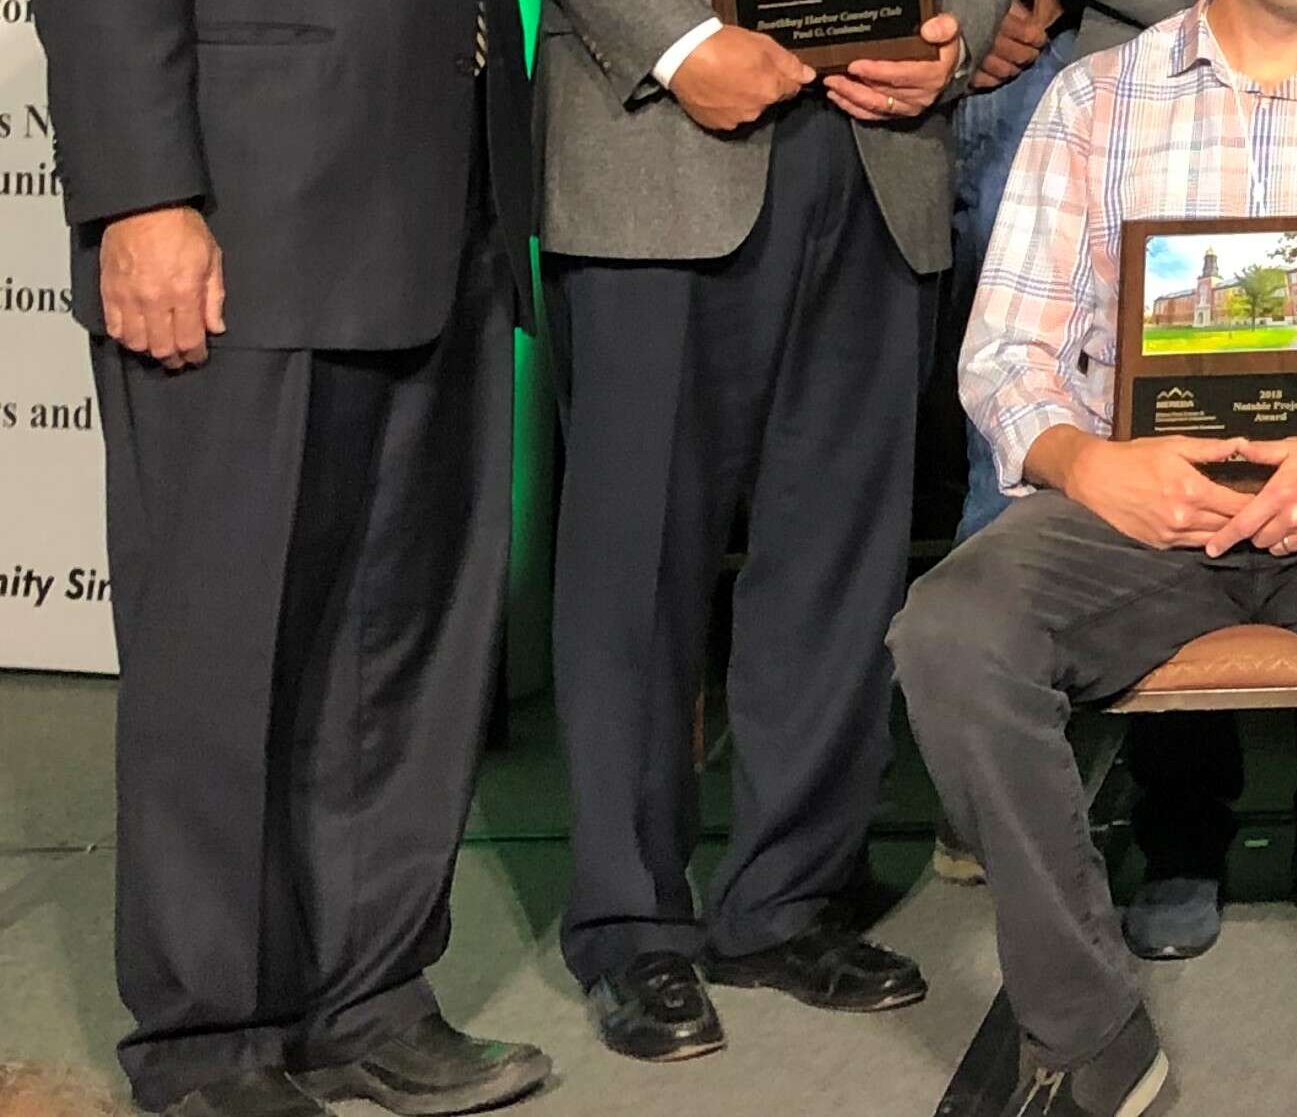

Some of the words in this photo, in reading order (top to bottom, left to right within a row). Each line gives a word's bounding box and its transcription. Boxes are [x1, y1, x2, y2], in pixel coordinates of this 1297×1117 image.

[840, 9, 878, 22] Country
[880, 6, 903, 17] Club
[0, 277, 72, 313] ions
[1259, 389, 1283, 399] 2018
[1233, 401, 1271, 412] Notable
[0, 402, 17, 428] s
[30, 397, 92, 431] and
[1254, 412, 1288, 423] Award
